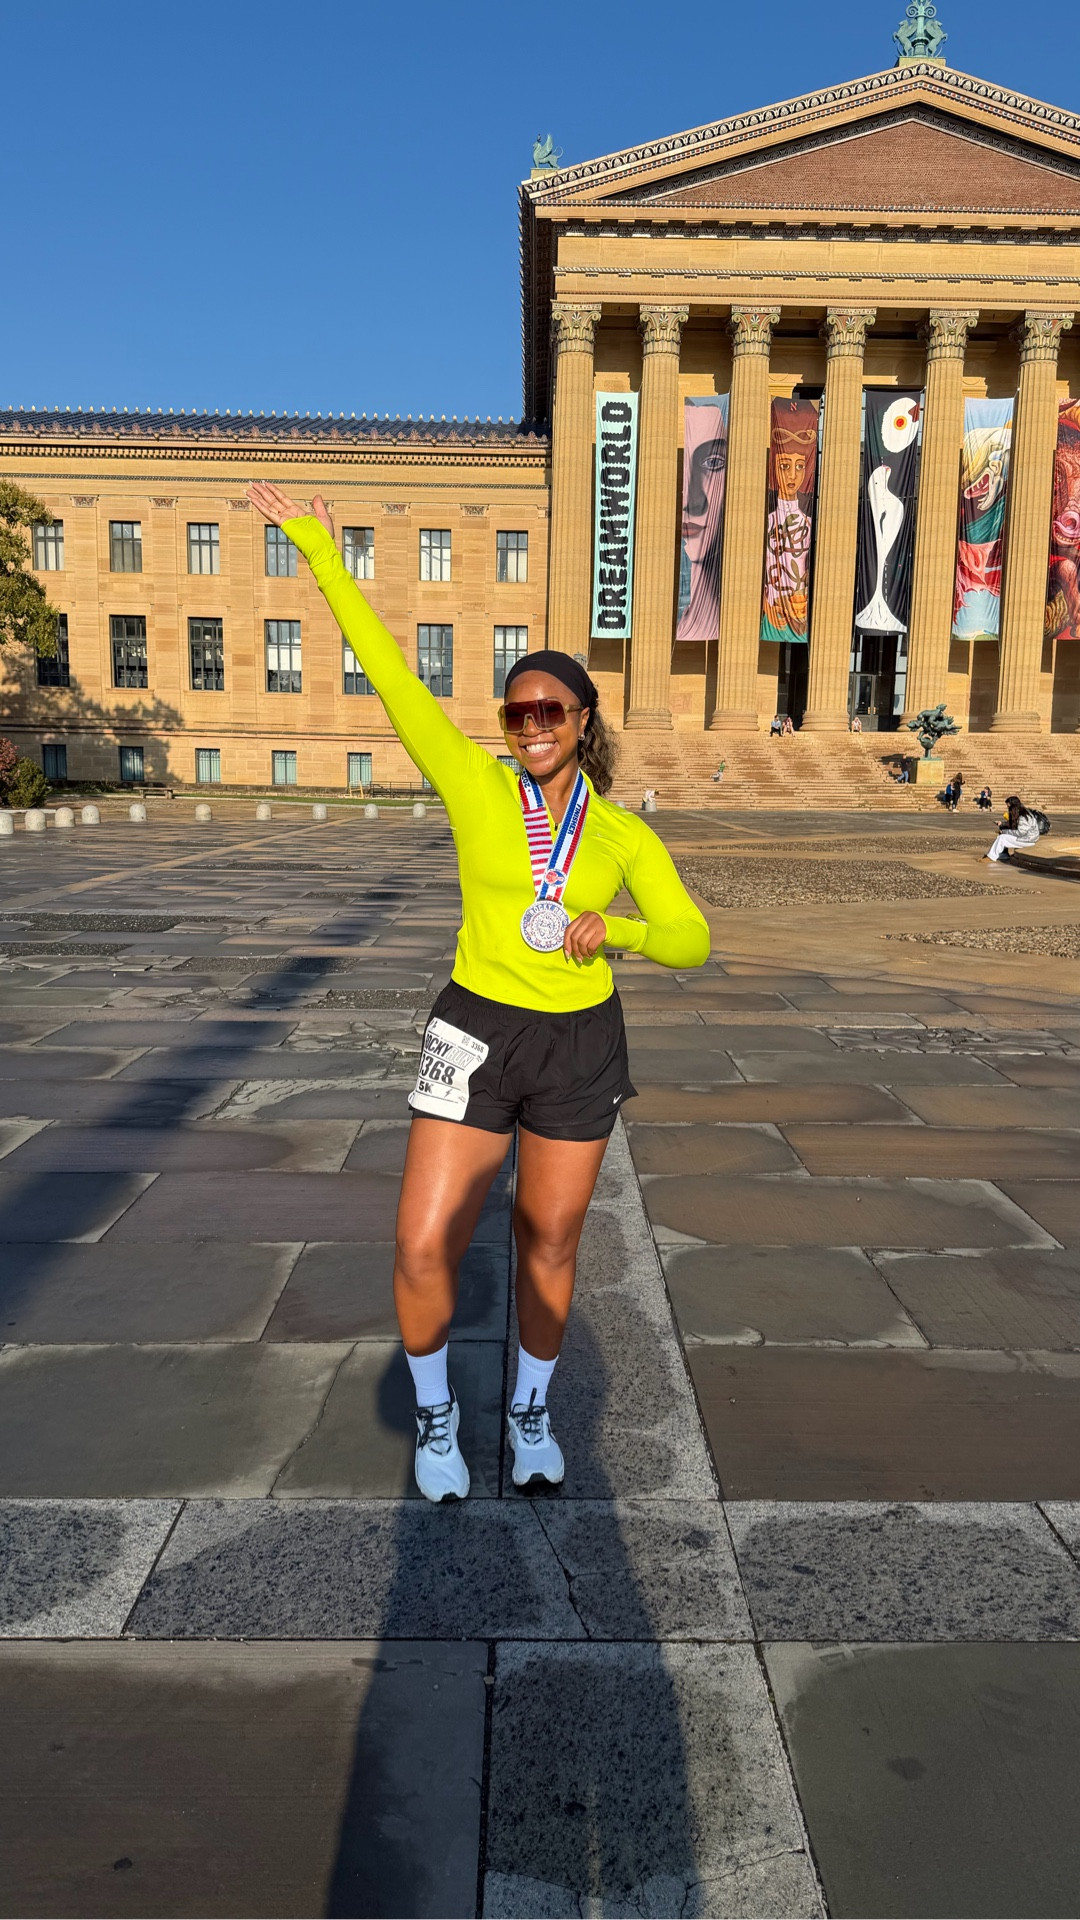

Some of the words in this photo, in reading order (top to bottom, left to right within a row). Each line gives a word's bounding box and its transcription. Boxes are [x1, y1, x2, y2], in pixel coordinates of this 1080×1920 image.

[597, 401, 632, 630] DREAMWORLD
[568, 803, 582, 835] FINISHER
[446, 1047, 474, 1068] RUN
[418, 1081, 434, 1094] 5K
